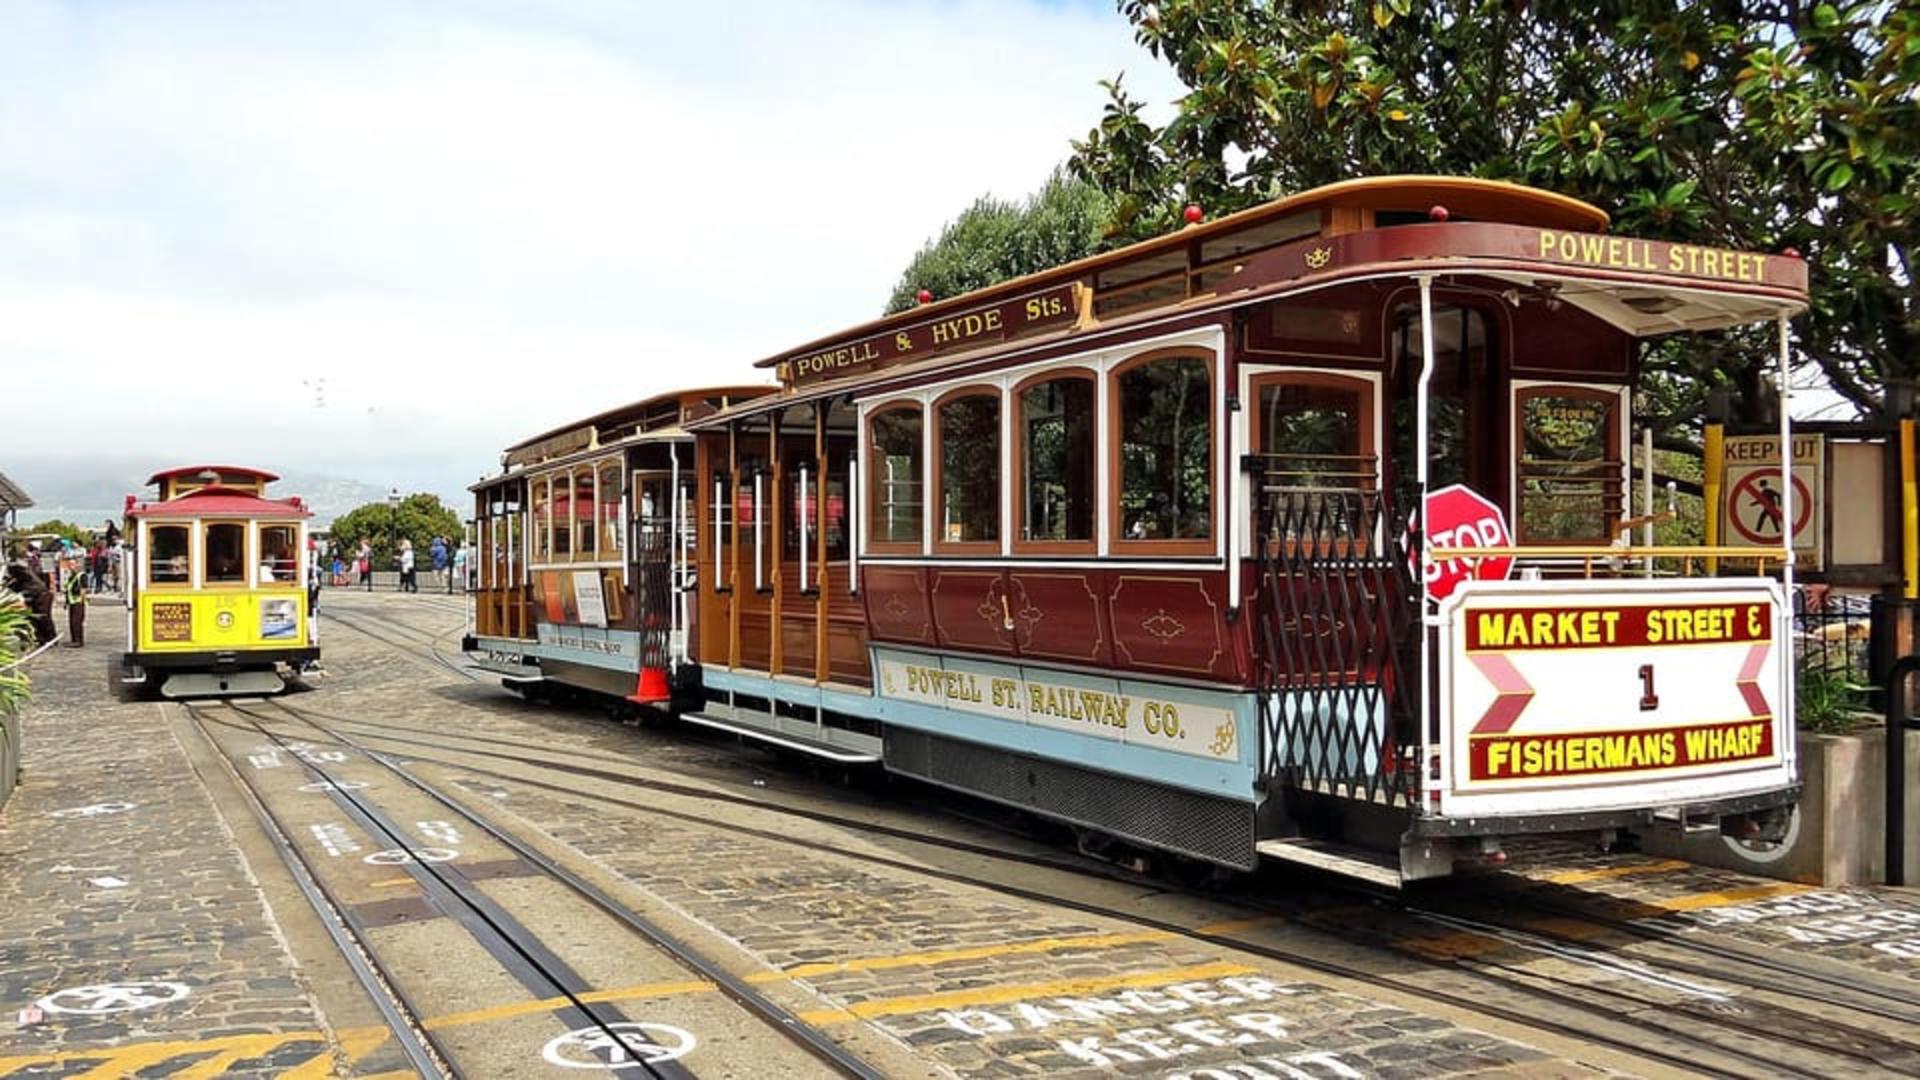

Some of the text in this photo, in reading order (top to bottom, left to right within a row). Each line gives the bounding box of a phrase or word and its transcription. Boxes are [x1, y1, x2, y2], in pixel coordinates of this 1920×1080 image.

[1539, 231, 1766, 281] POWELL STREET
[797, 297, 1067, 376] POWELL & HYDE Sts.
[1724, 440, 1815, 459] KEEP UT
[1479, 611, 1620, 645] MARKET
[1647, 608, 1736, 642] STREET
[906, 666, 1185, 739] POWELL ST. RAILWAY CO.
[1638, 664, 1659, 712] 1
[1487, 724, 1763, 775] FISHERMANS WHARF
[938, 976, 1284, 1035] DANGER
[1057, 1011, 1293, 1066] KEEP
